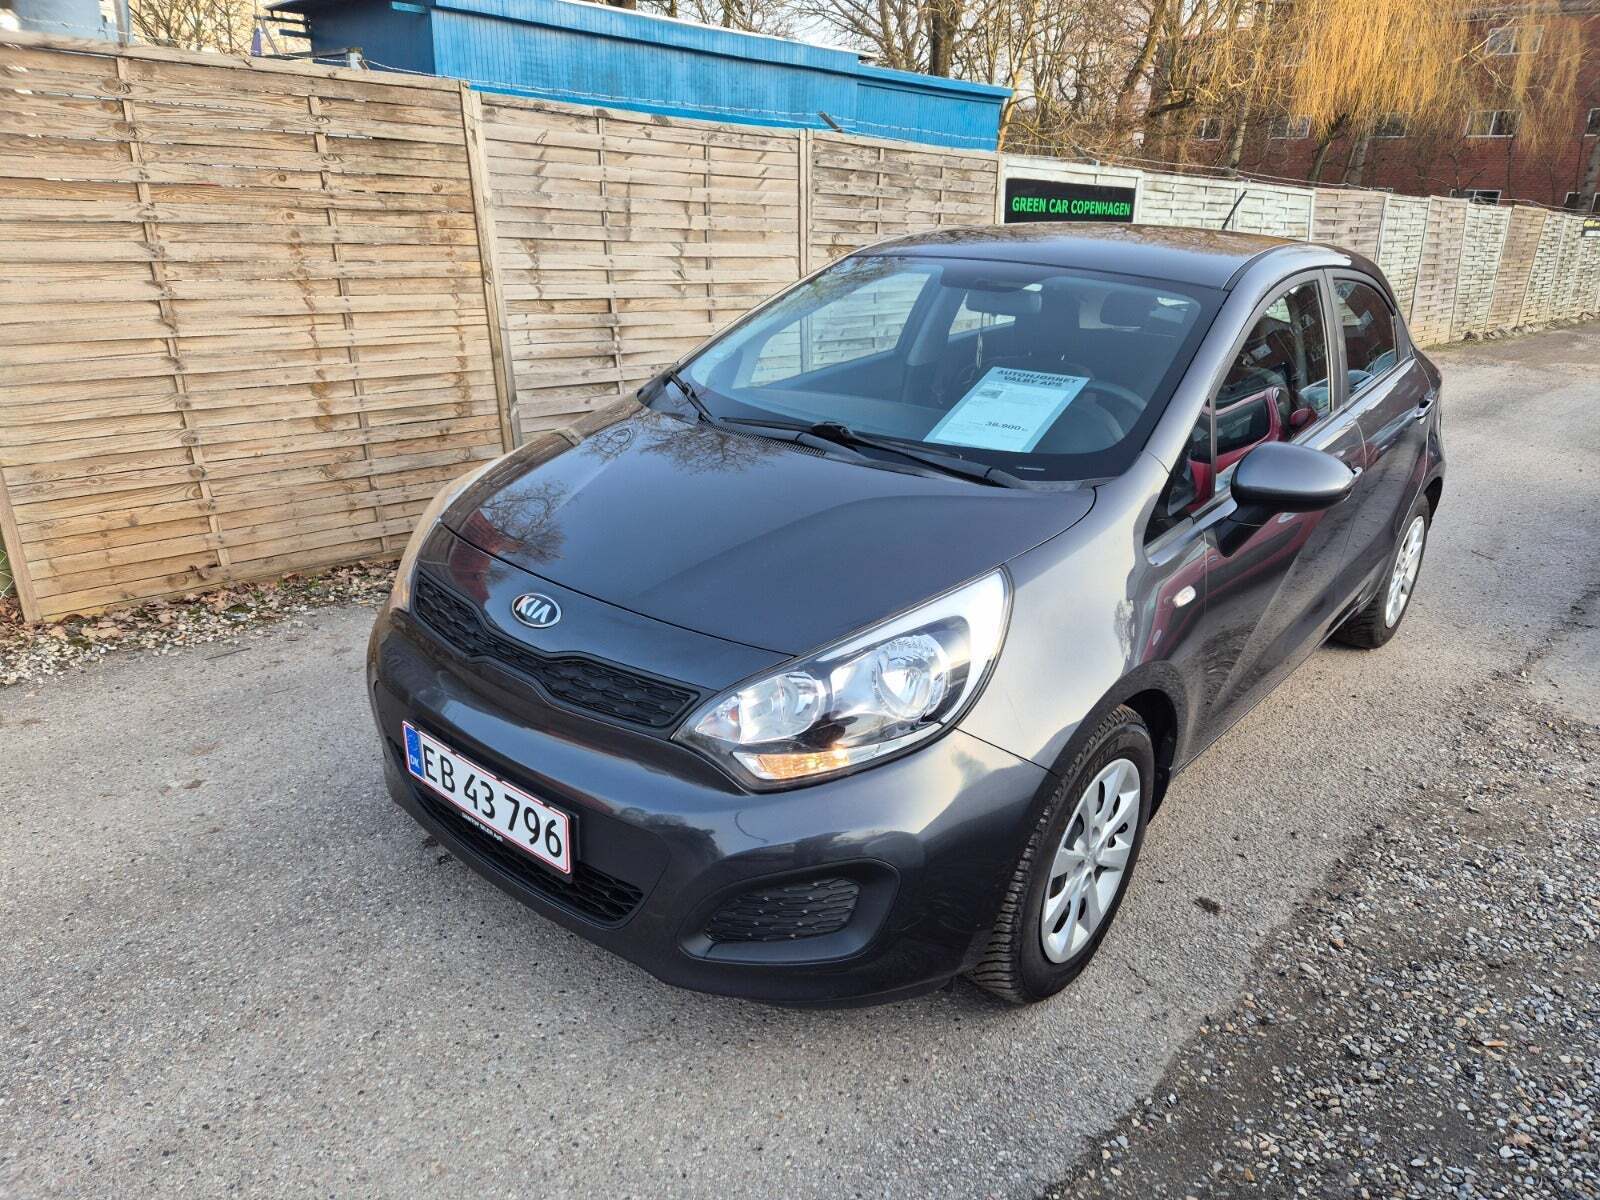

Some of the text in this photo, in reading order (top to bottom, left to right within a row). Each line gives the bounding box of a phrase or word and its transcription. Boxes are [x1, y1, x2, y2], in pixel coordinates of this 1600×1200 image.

[1012, 197, 1131, 216] GREEN CAR COPENHAGEN
[1004, 375, 1038, 384] VALBY
[515, 595, 552, 623] KIA
[409, 754, 420, 768] DK
[422, 744, 456, 794] EB
[463, 774, 496, 820] 43
[504, 793, 563, 858] 796
